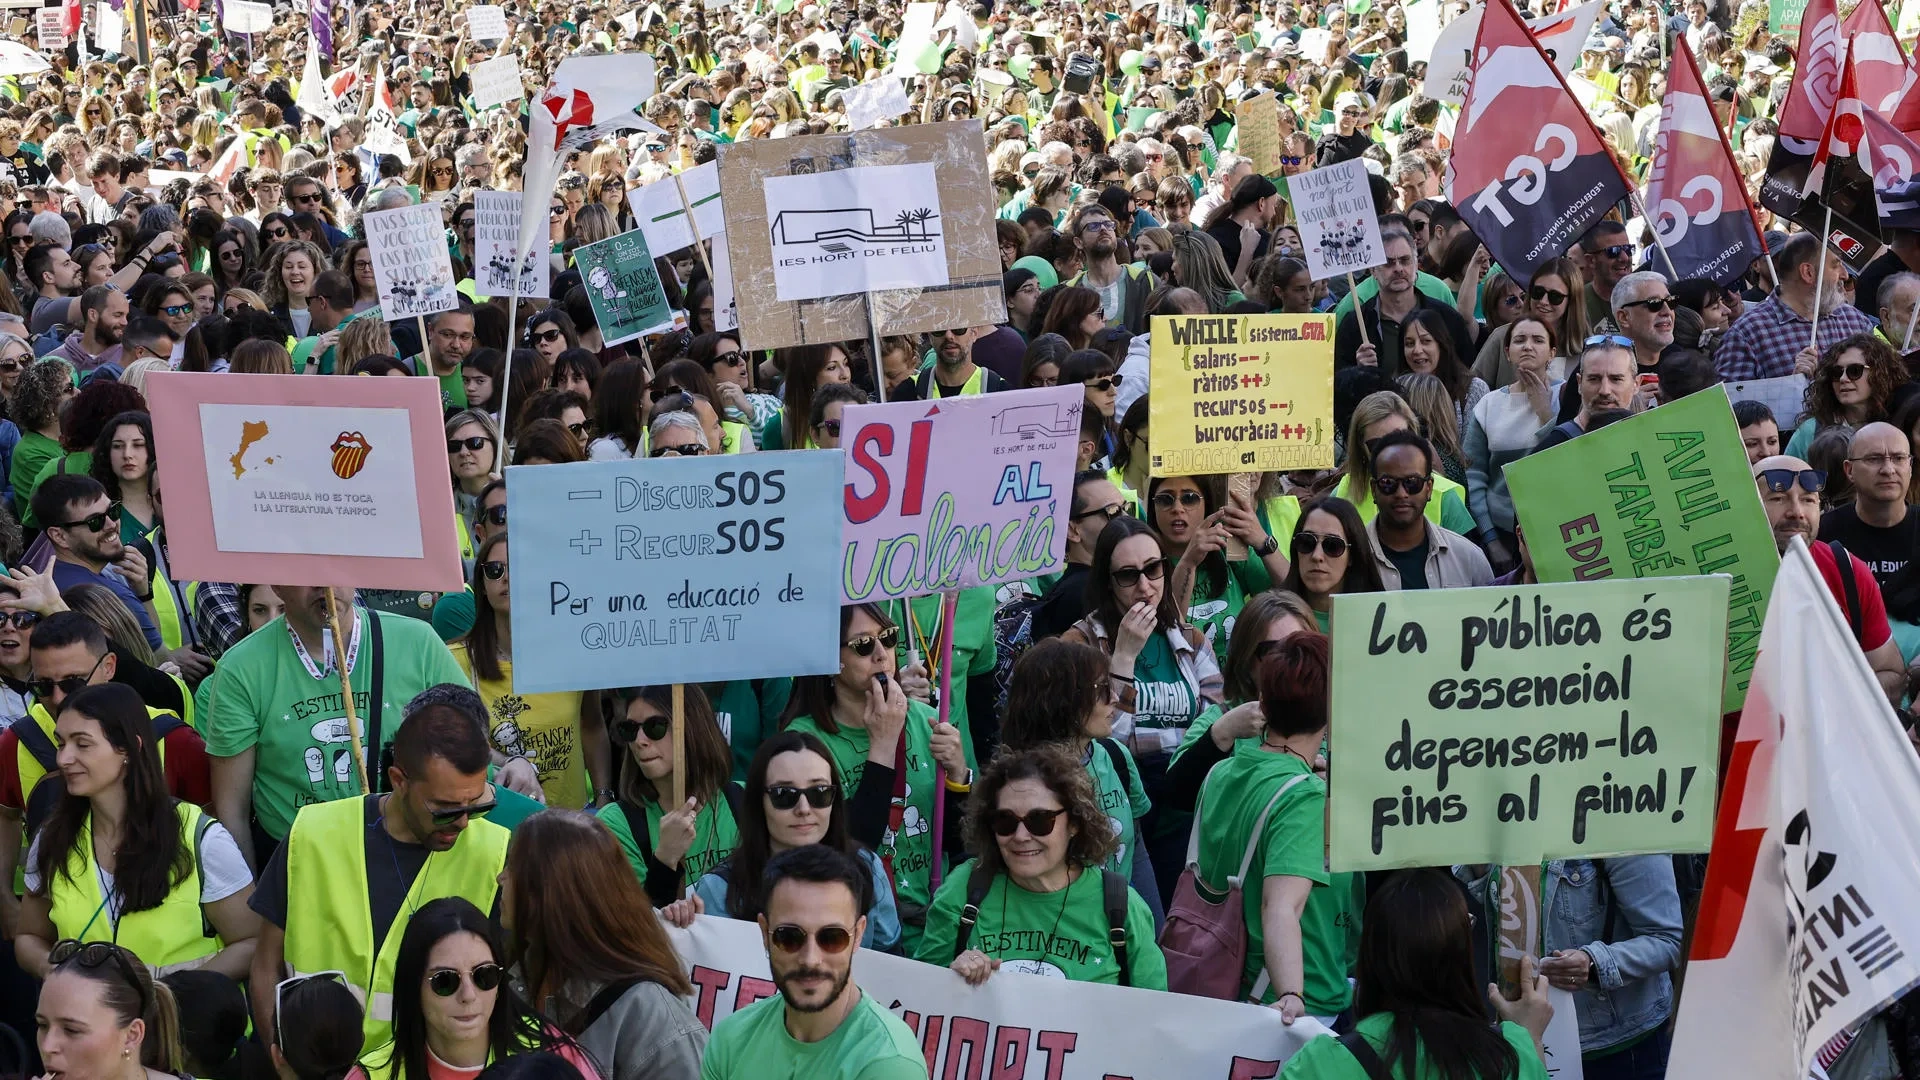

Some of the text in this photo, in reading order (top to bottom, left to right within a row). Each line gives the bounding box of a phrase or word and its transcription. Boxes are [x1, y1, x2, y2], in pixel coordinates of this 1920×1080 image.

[1765, 173, 1802, 199] SINDICATO
[614, 238, 635, 251] 0-3
[779, 245, 936, 267] IES HORT DE FELIU
[843, 404, 941, 525] SÍ
[1240, 450, 1256, 465] en
[254, 490, 374, 503] LA LLENGUA NO ES TOCA
[993, 461, 1053, 506] AL
[260, 503, 273, 513] LA
[274, 504, 334, 515] LITERATURA
[335, 506, 377, 516] TAMPOC
[1604, 451, 1686, 578] TAMBÉ
[1559, 513, 1614, 581] EDU
[385, 597, 415, 607] LONDON
[550, 573, 805, 616] Per una educació de
[1368, 592, 1673, 672] La pública és
[1134, 680, 1191, 715] LLENGUA
[1428, 654, 1632, 710] essencial
[1384, 709, 1658, 792] defensem-la
[1371, 785, 1469, 856] fins
[1497, 773, 1540, 822] al
[980, 930, 1093, 966] ESTIMEM
